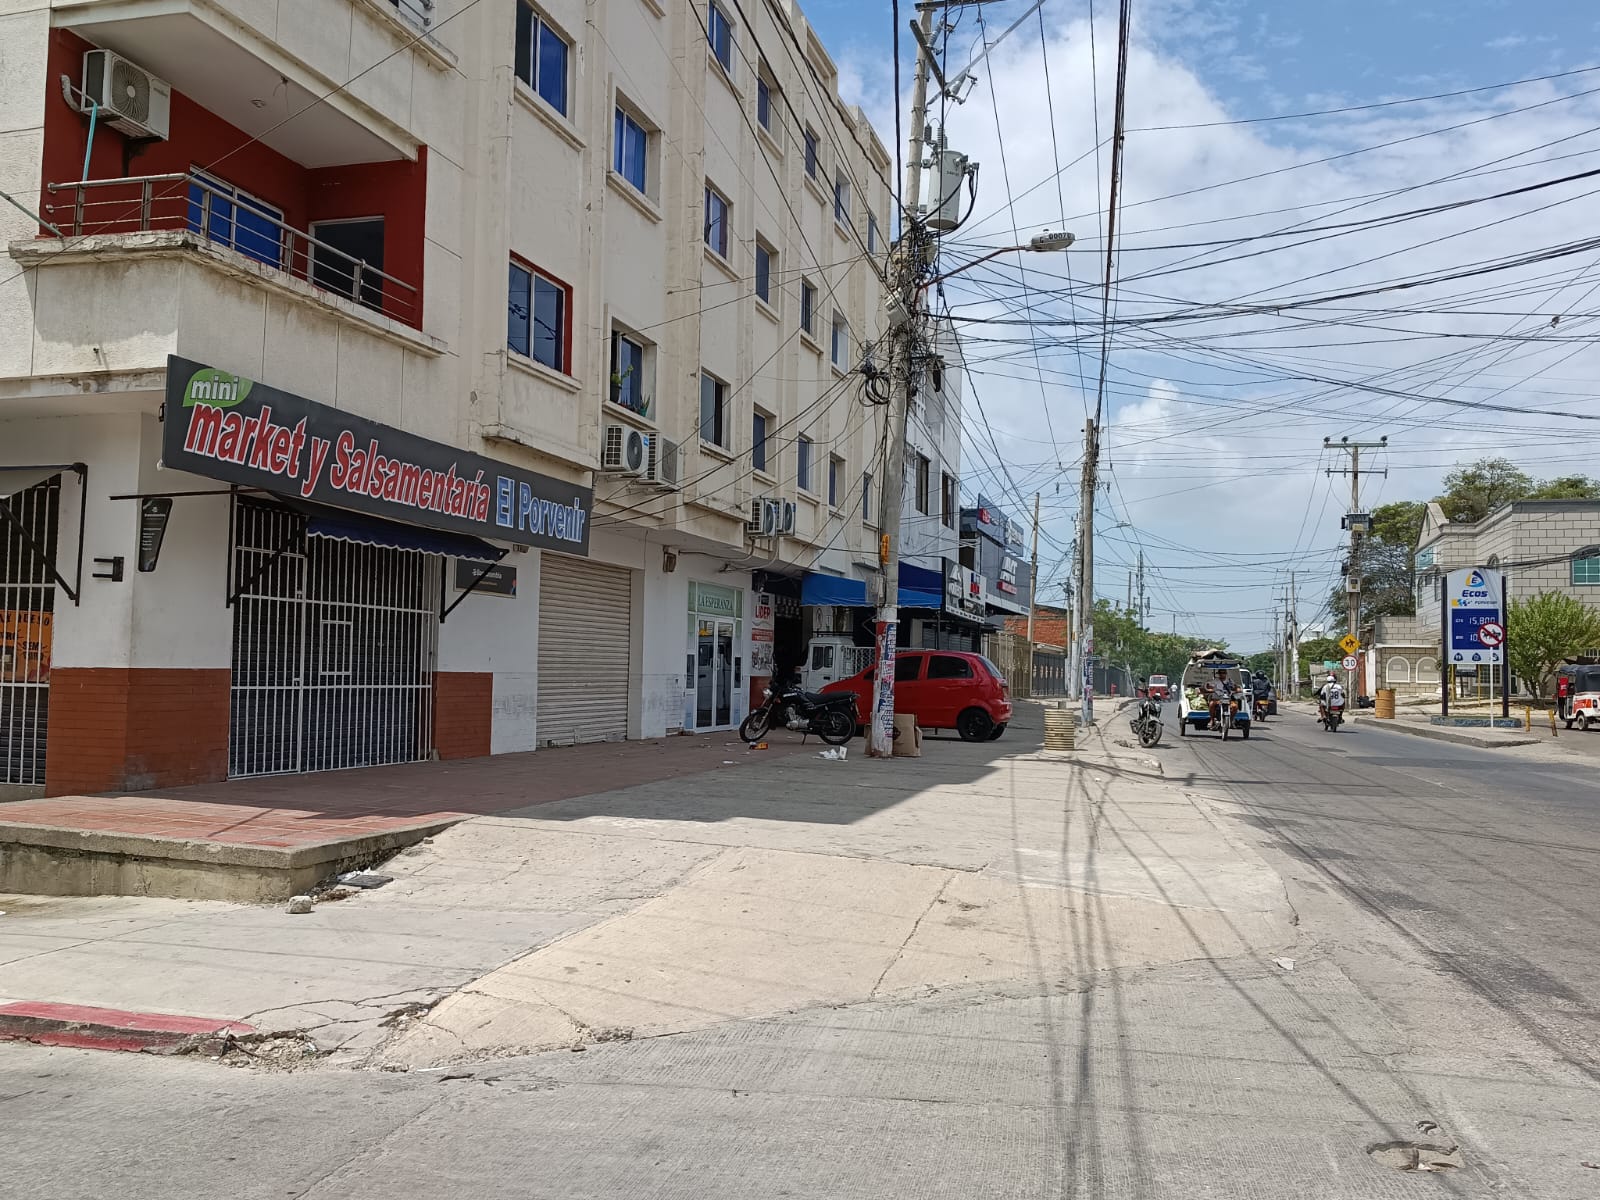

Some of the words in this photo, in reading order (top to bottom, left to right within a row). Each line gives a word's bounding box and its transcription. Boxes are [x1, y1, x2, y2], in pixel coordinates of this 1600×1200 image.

[190, 375, 239, 401] mini
[184, 402, 307, 477] market
[301, 435, 330, 497] y
[330, 430, 490, 522] Salsamentaría
[496, 475, 514, 528] El
[518, 481, 586, 543] Porvenir
[1462, 590, 1488, 598] Ecos
